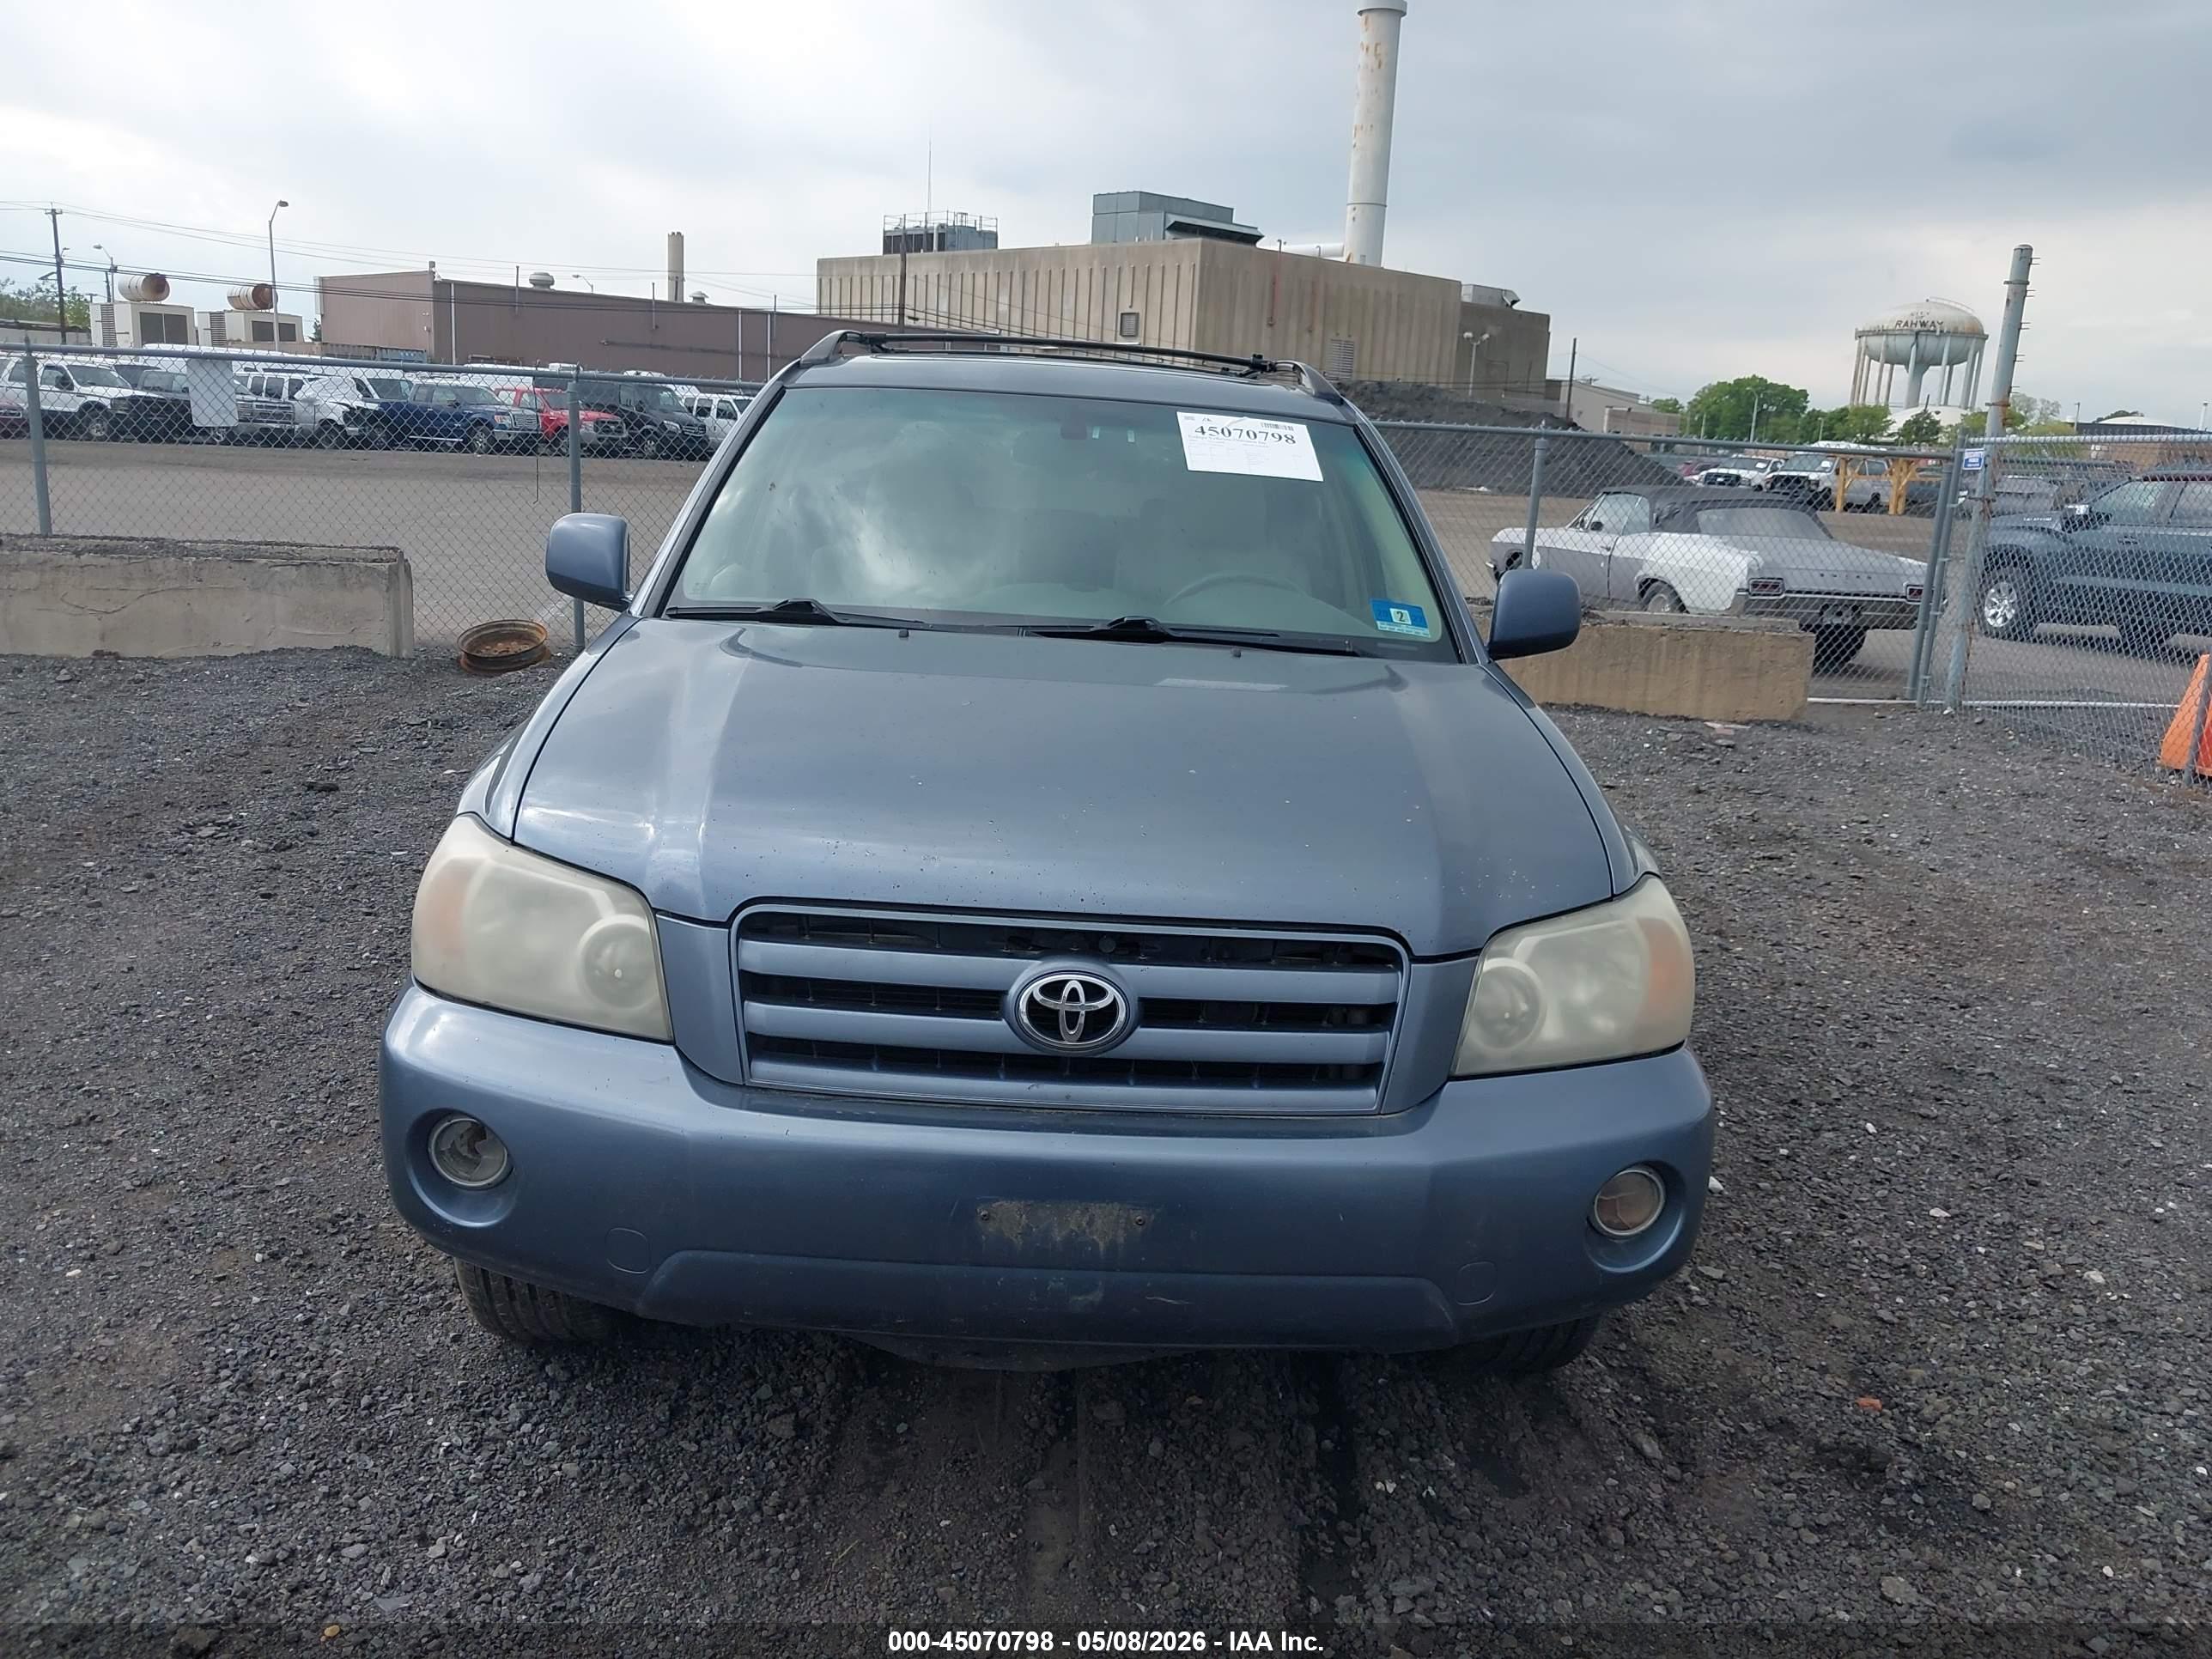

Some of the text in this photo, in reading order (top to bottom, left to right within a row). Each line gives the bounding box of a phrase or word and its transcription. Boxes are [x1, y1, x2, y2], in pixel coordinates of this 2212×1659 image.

[1895, 319, 1944, 329] RAHWAY
[1194, 425, 1297, 445] 45070798
[1396, 611, 1406, 622] 2
